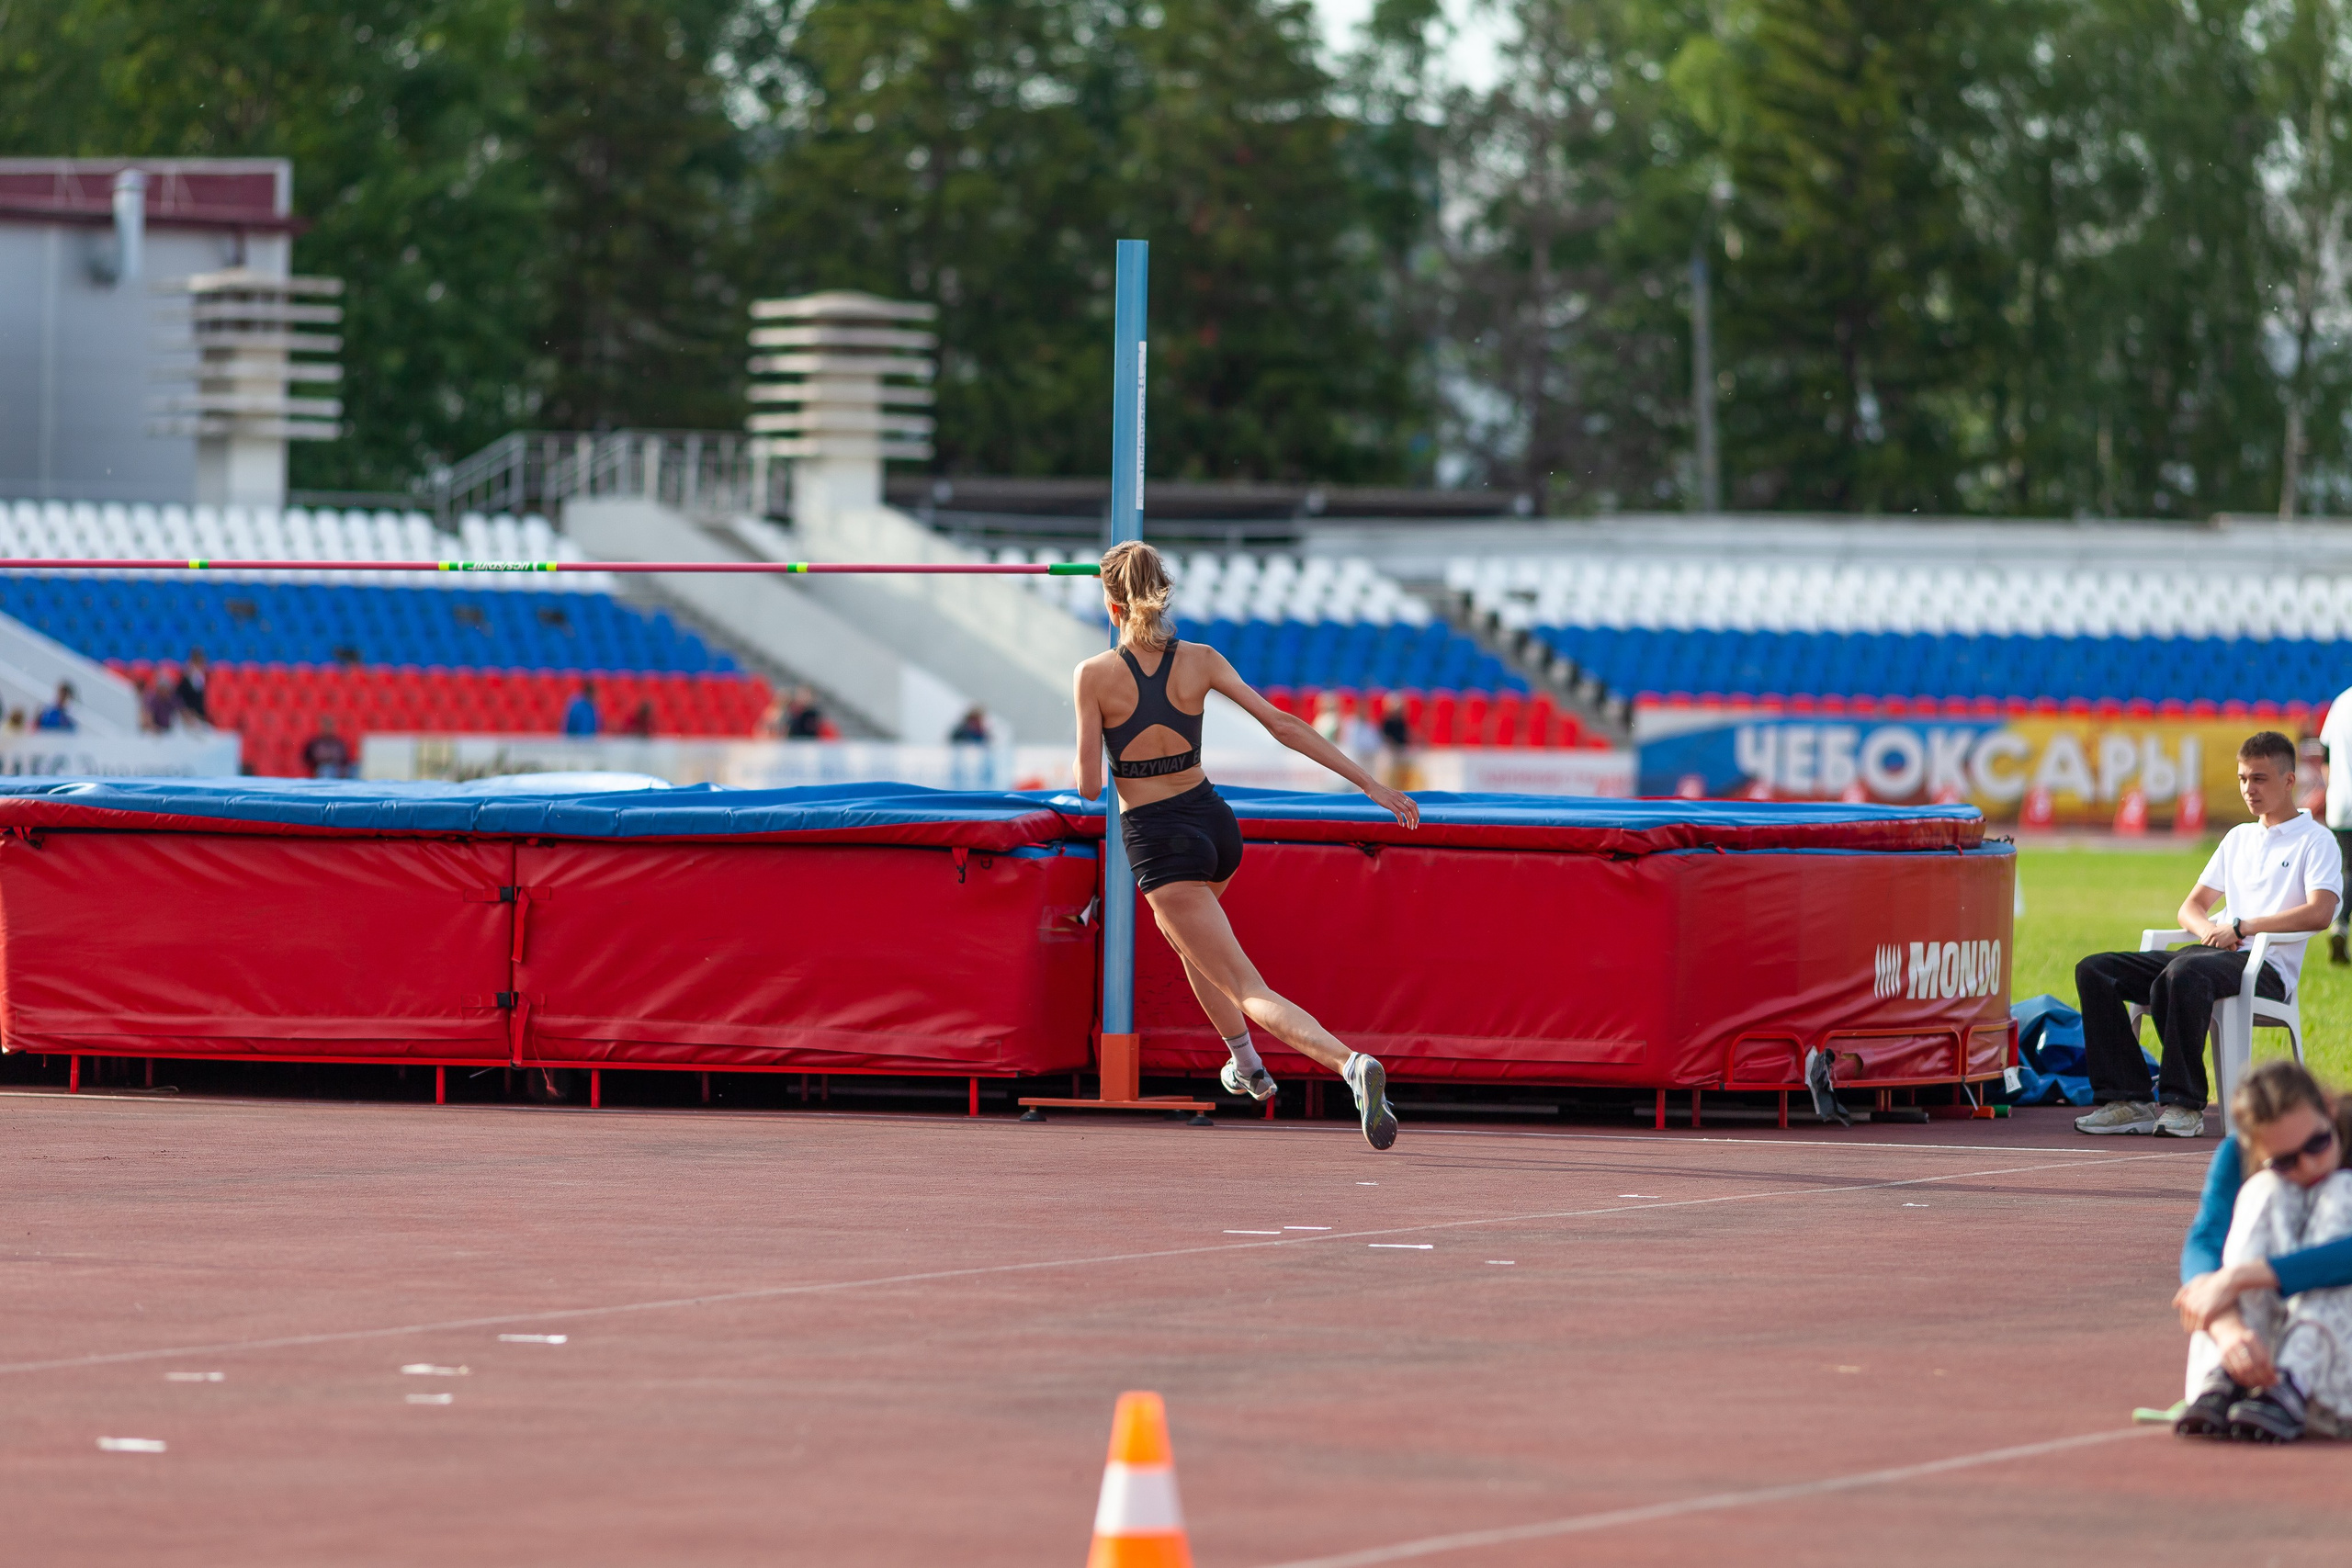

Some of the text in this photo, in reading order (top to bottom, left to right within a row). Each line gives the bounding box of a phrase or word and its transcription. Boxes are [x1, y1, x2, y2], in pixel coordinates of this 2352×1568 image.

[1121, 756, 1186, 777] EAZYWAY
[1735, 726, 2202, 801] ЧЕБОКСАРЫ
[1906, 939, 2000, 999] MONDO
